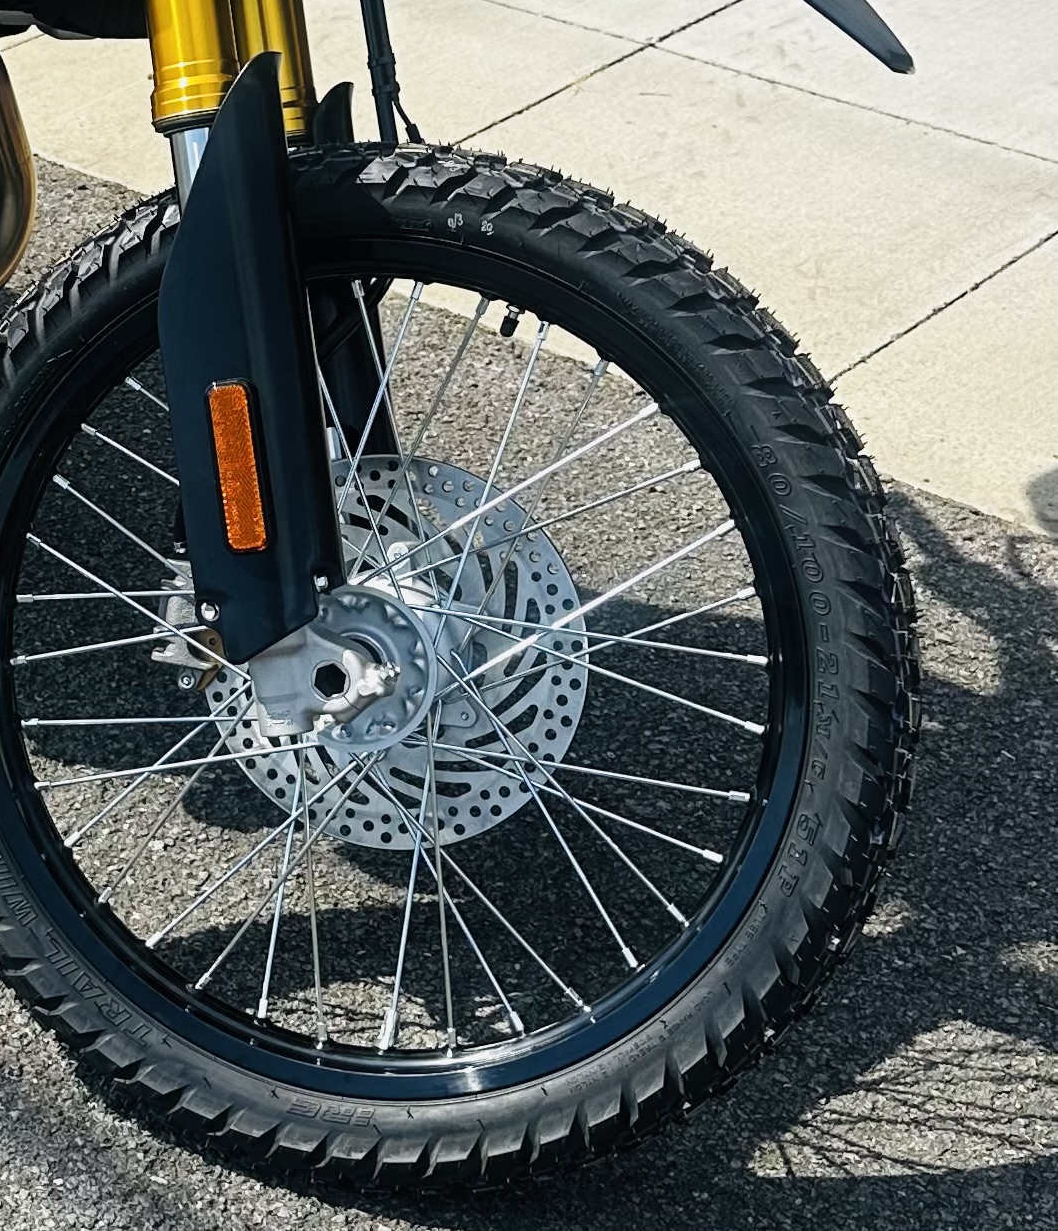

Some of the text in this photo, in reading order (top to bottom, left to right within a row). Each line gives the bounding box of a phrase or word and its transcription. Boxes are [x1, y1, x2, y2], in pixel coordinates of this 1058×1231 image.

[774, 812, 822, 898] 51P
[38, 934, 152, 1048] TRAIL
[285, 1093, 375, 1128] IRC
